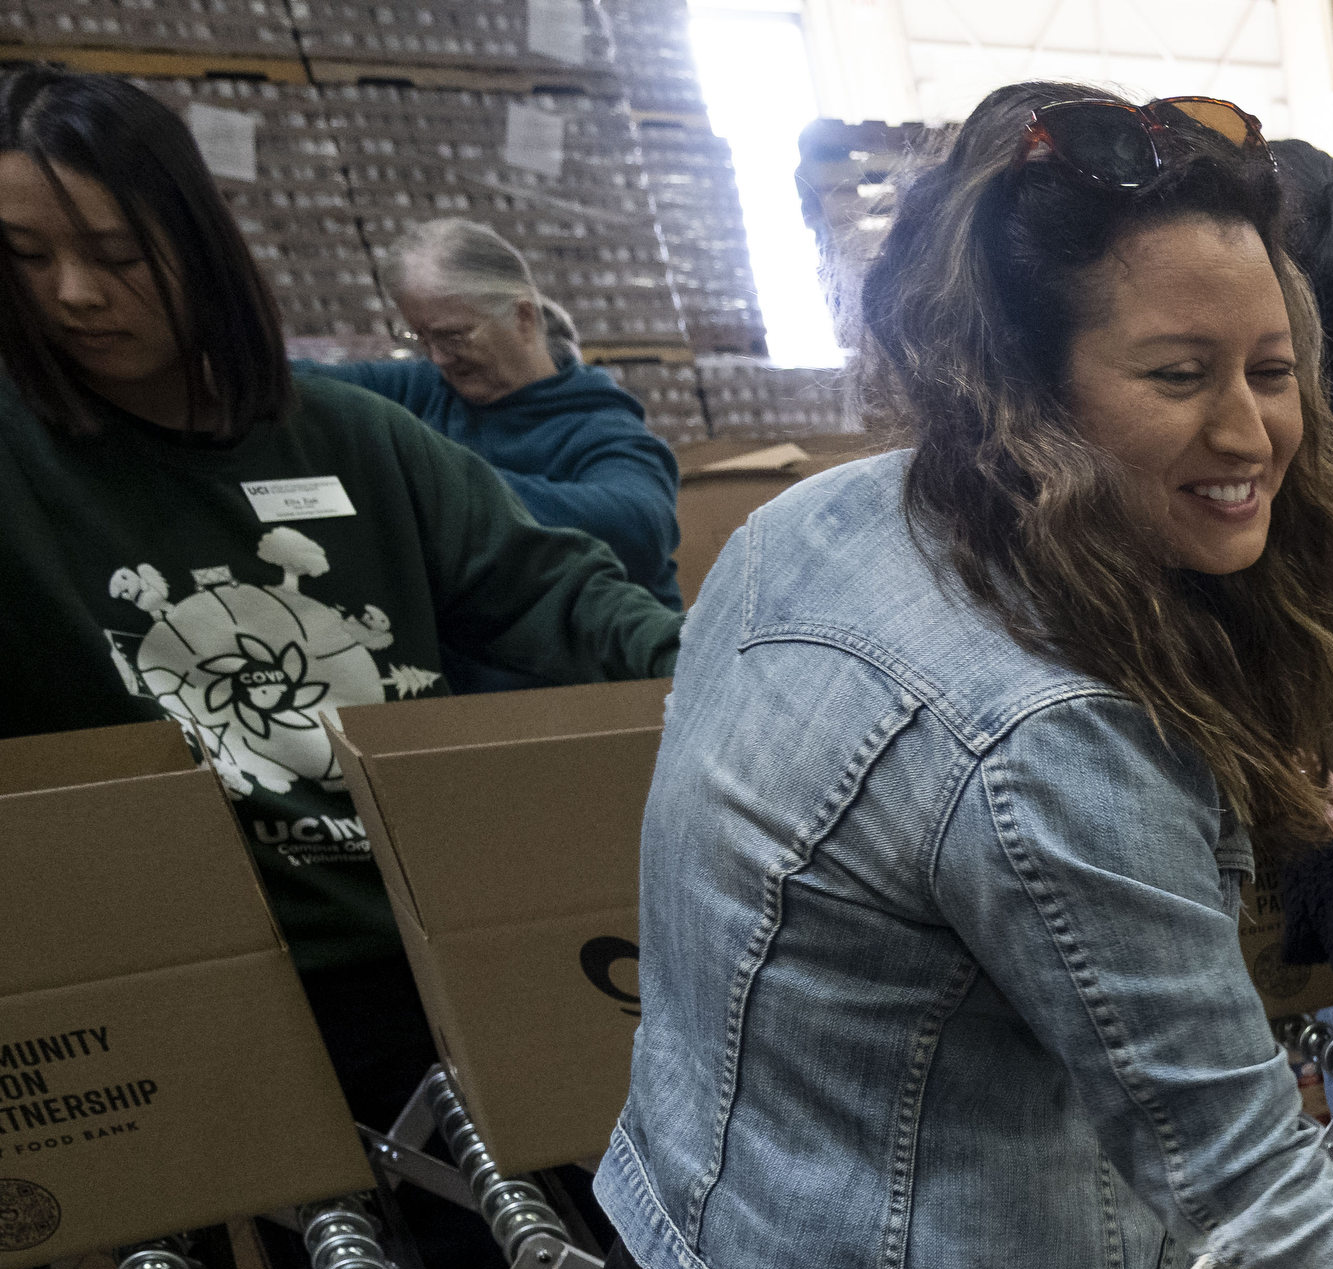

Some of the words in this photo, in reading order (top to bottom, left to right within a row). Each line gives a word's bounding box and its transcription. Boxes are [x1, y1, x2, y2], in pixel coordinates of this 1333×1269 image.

[247, 486, 270, 496] UCI
[239, 669, 285, 685] COVP
[14, 1134, 74, 1155] FOOD
[83, 1121, 140, 1141] BANK
